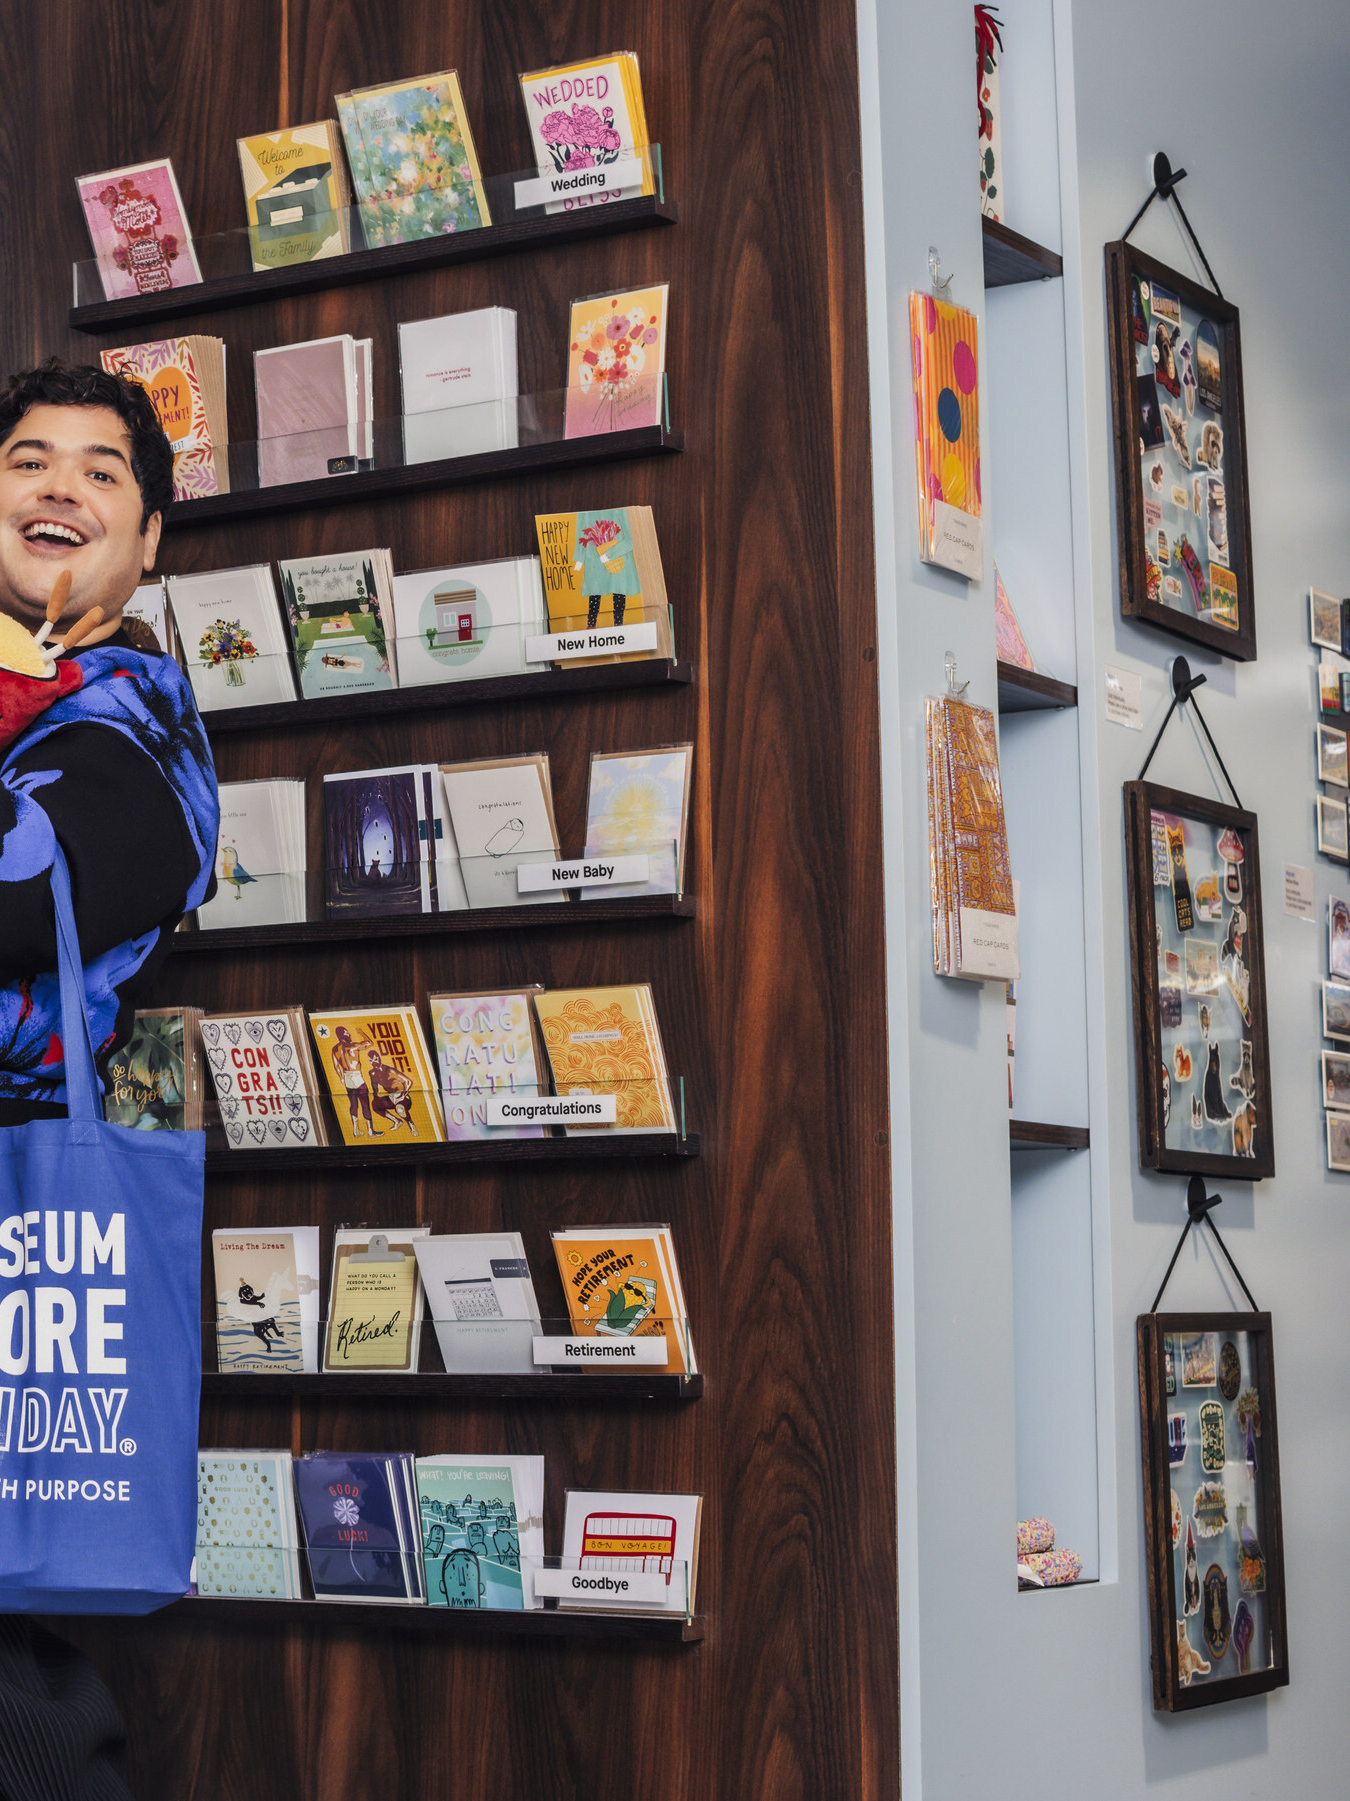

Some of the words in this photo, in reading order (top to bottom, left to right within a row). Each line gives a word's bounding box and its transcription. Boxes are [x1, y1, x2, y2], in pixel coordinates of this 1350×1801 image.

[533, 75, 608, 110] WEDDED
[258, 146, 304, 165] Welcome
[274, 164, 284, 176] to
[552, 172, 606, 192] Wedding
[262, 242, 277, 260] the
[280, 240, 316, 257] Family
[449, 367, 471, 376] everything
[542, 521, 570, 545] HAPPY
[546, 545, 569, 566] NEW
[298, 568, 308, 578] you
[310, 566, 330, 578] bought
[338, 562, 358, 572] house!
[547, 566, 576, 590] HOME
[558, 639, 584, 651] New
[589, 634, 625, 648] Home
[432, 647, 459, 658] congrats
[478, 800, 522, 812] congratulations
[552, 867, 580, 882] New
[583, 864, 614, 880] Baby
[1177, 899, 1189, 909] COOL
[1178, 908, 1191, 916] CATS
[1180, 918, 1192, 927] READ
[973, 938, 982, 946] RED
[994, 942, 1009, 950] CARDS
[367, 1022, 400, 1039] YOU
[440, 1012, 512, 1034] CONG
[377, 1040, 404, 1056] DID
[444, 1042, 516, 1066] RATU
[231, 1047, 270, 1068] CON
[392, 1056, 412, 1072] IT!
[114, 1064, 126, 1078] so
[237, 1072, 278, 1093] GRA
[448, 1072, 516, 1096] LATI
[111, 1081, 133, 1106] for
[136, 1079, 173, 1112] you!
[244, 1095, 283, 1116] TS!!
[502, 1102, 602, 1119] Congratulations
[220, 1243, 244, 1251] Living
[262, 1242, 286, 1250] Dream
[572, 1265, 592, 1288] HOPE
[590, 1249, 617, 1268] YOUR
[578, 1254, 634, 1304] RETIREMENT
[565, 1344, 636, 1357] Retirement
[26, 1480, 130, 1501] PURPOSE
[328, 1484, 359, 1498] GOOD
[338, 1530, 369, 1542] LUCK!
[592, 1541, 612, 1549] BON
[622, 1542, 667, 1550] VOYAGE!
[572, 1576, 629, 1590] Goodbye
